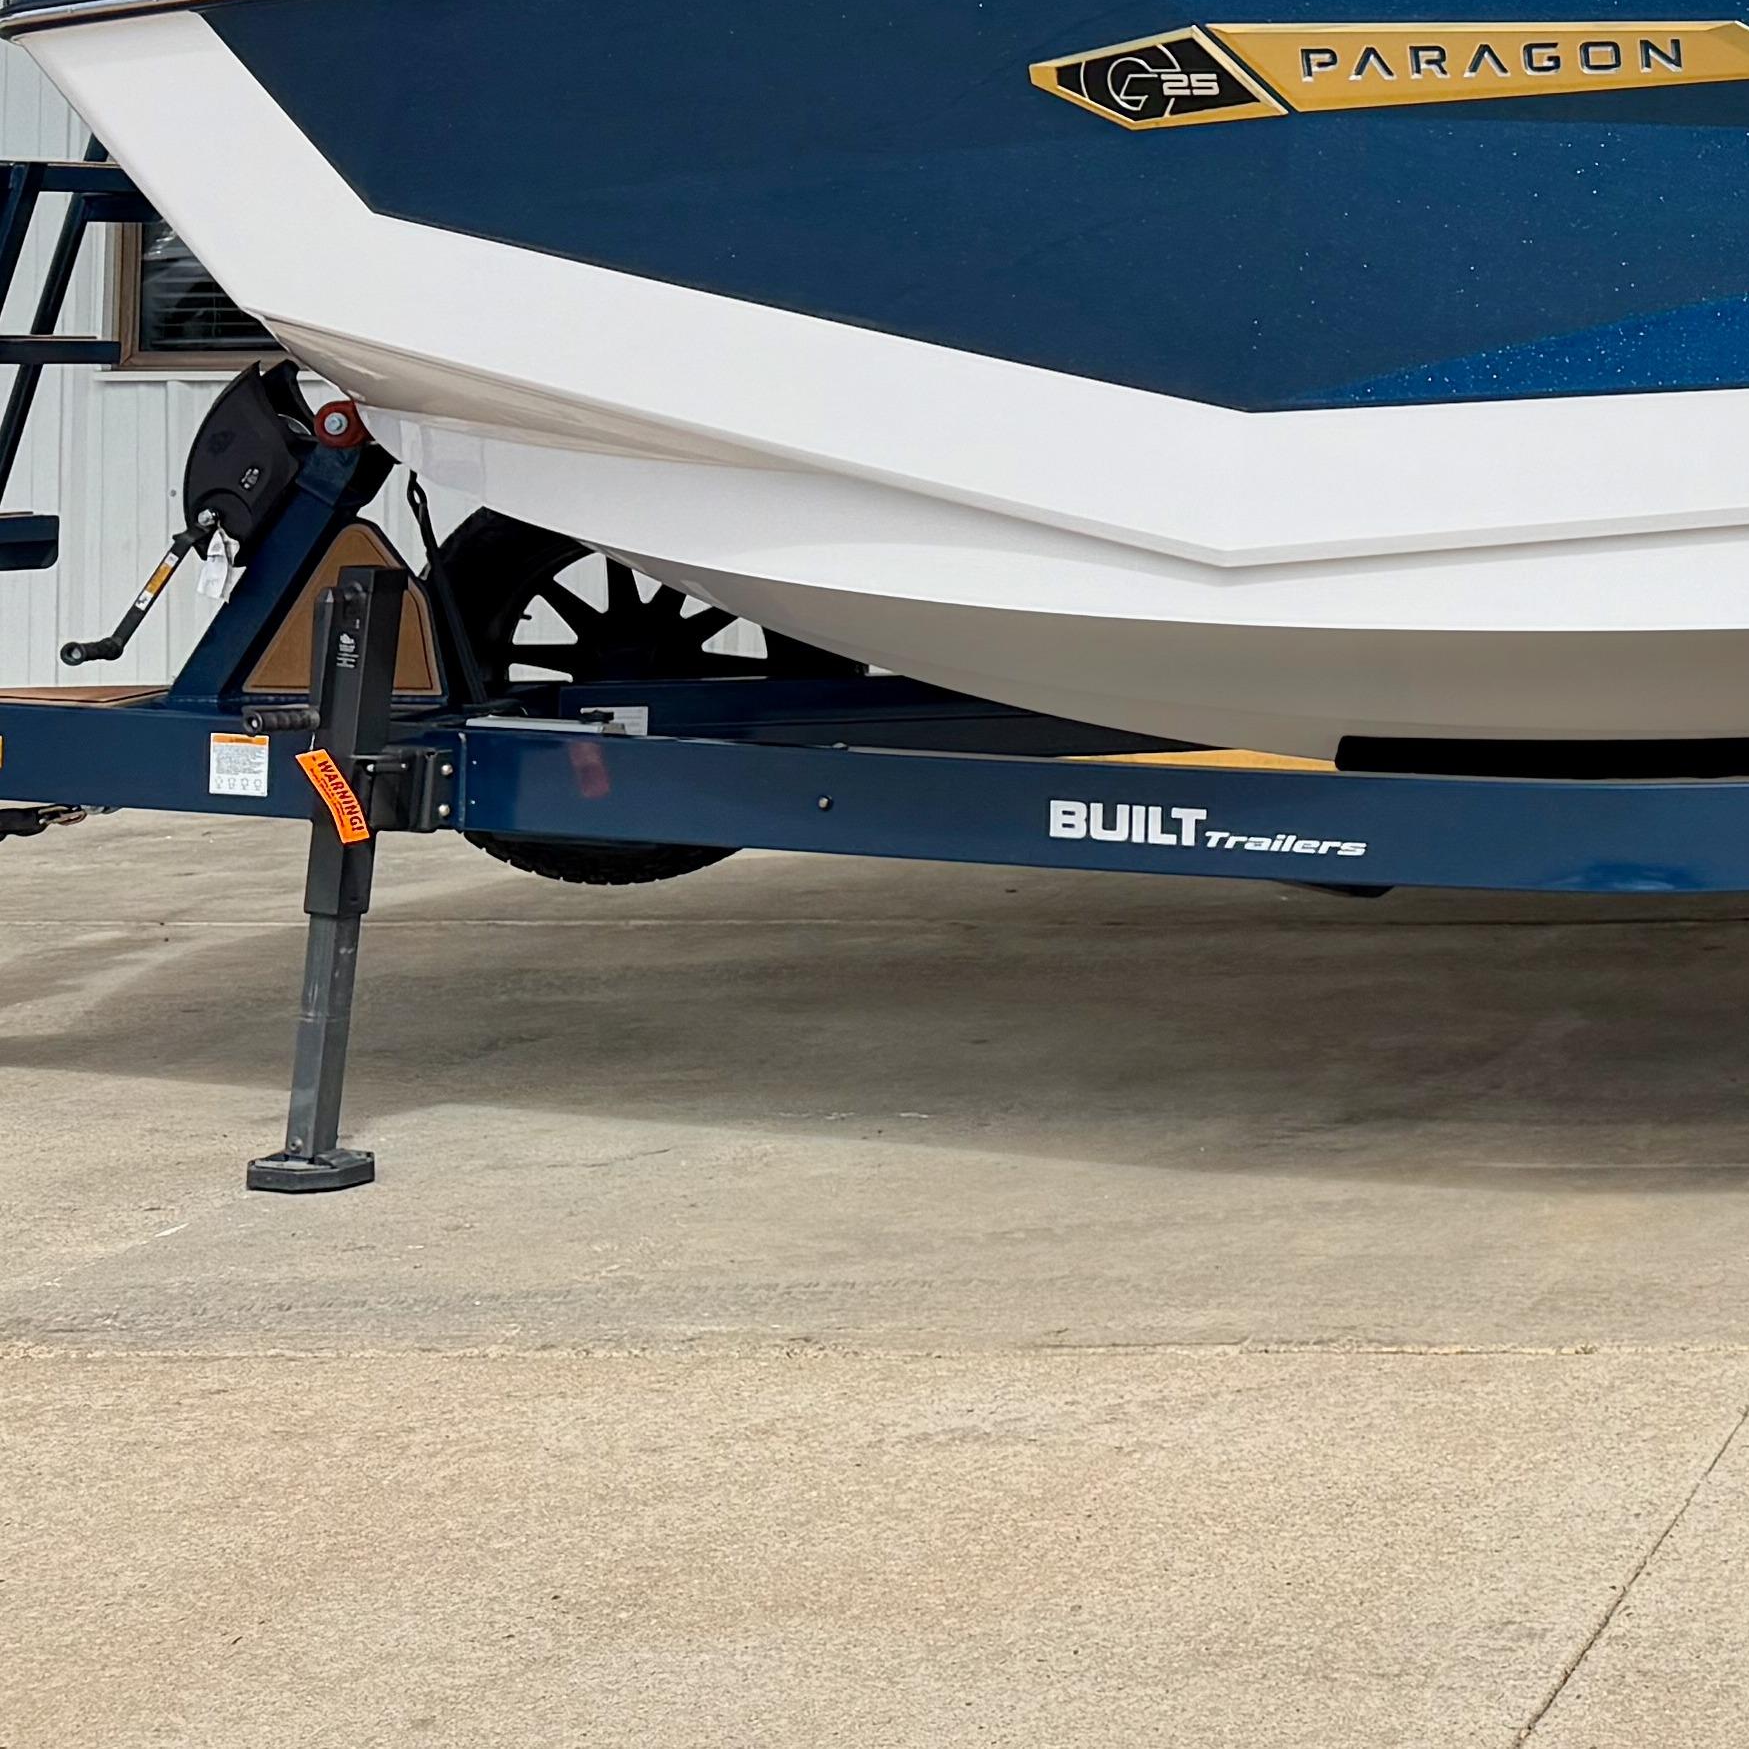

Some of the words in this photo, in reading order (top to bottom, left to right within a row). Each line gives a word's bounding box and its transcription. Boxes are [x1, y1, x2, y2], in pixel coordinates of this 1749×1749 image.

[1301, 38, 1685, 83] PARAGON
[317, 760, 365, 832] WARNING!
[1049, 800, 1207, 847] BUILT
[1204, 830, 1368, 857] Trailers
